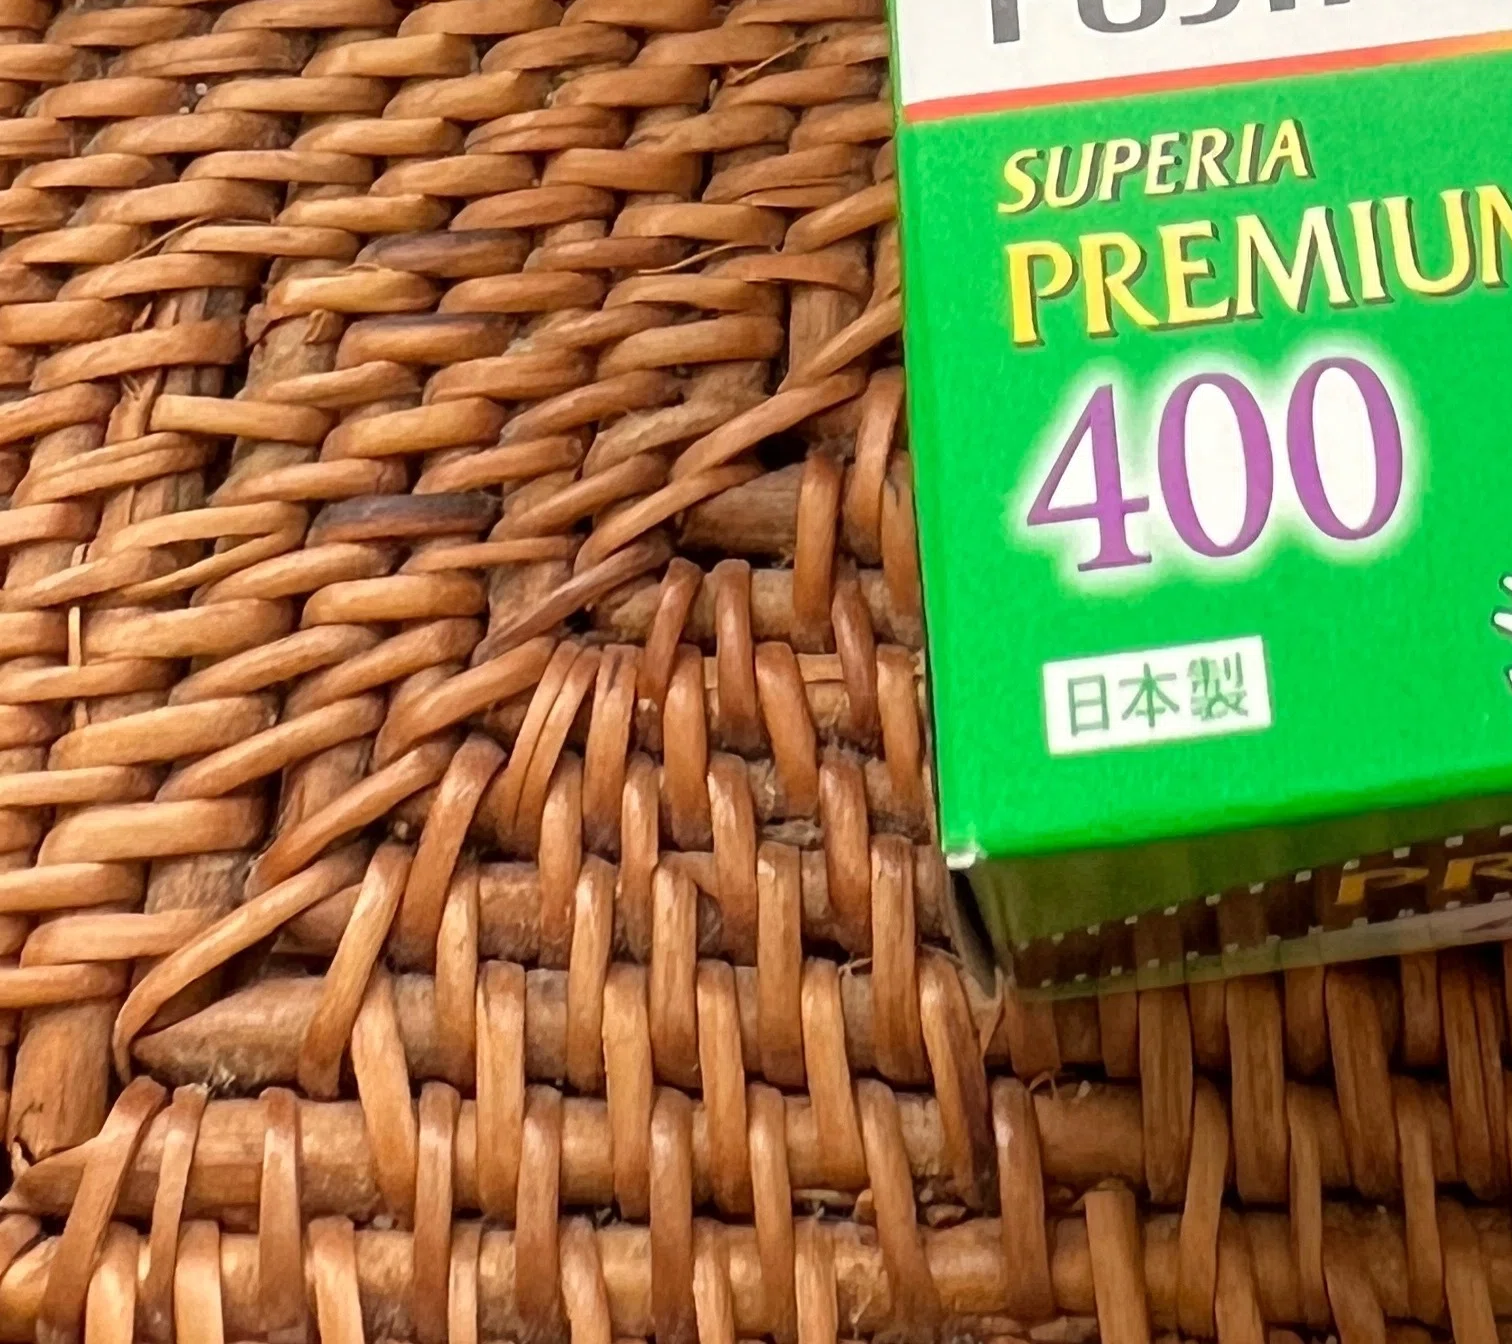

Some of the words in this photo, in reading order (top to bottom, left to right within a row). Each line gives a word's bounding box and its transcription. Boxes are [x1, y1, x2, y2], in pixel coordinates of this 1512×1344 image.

[997, 118, 1317, 216] SUPERIA
[1026, 356, 1403, 573] 400
[1066, 650, 1250, 737] 日本製
